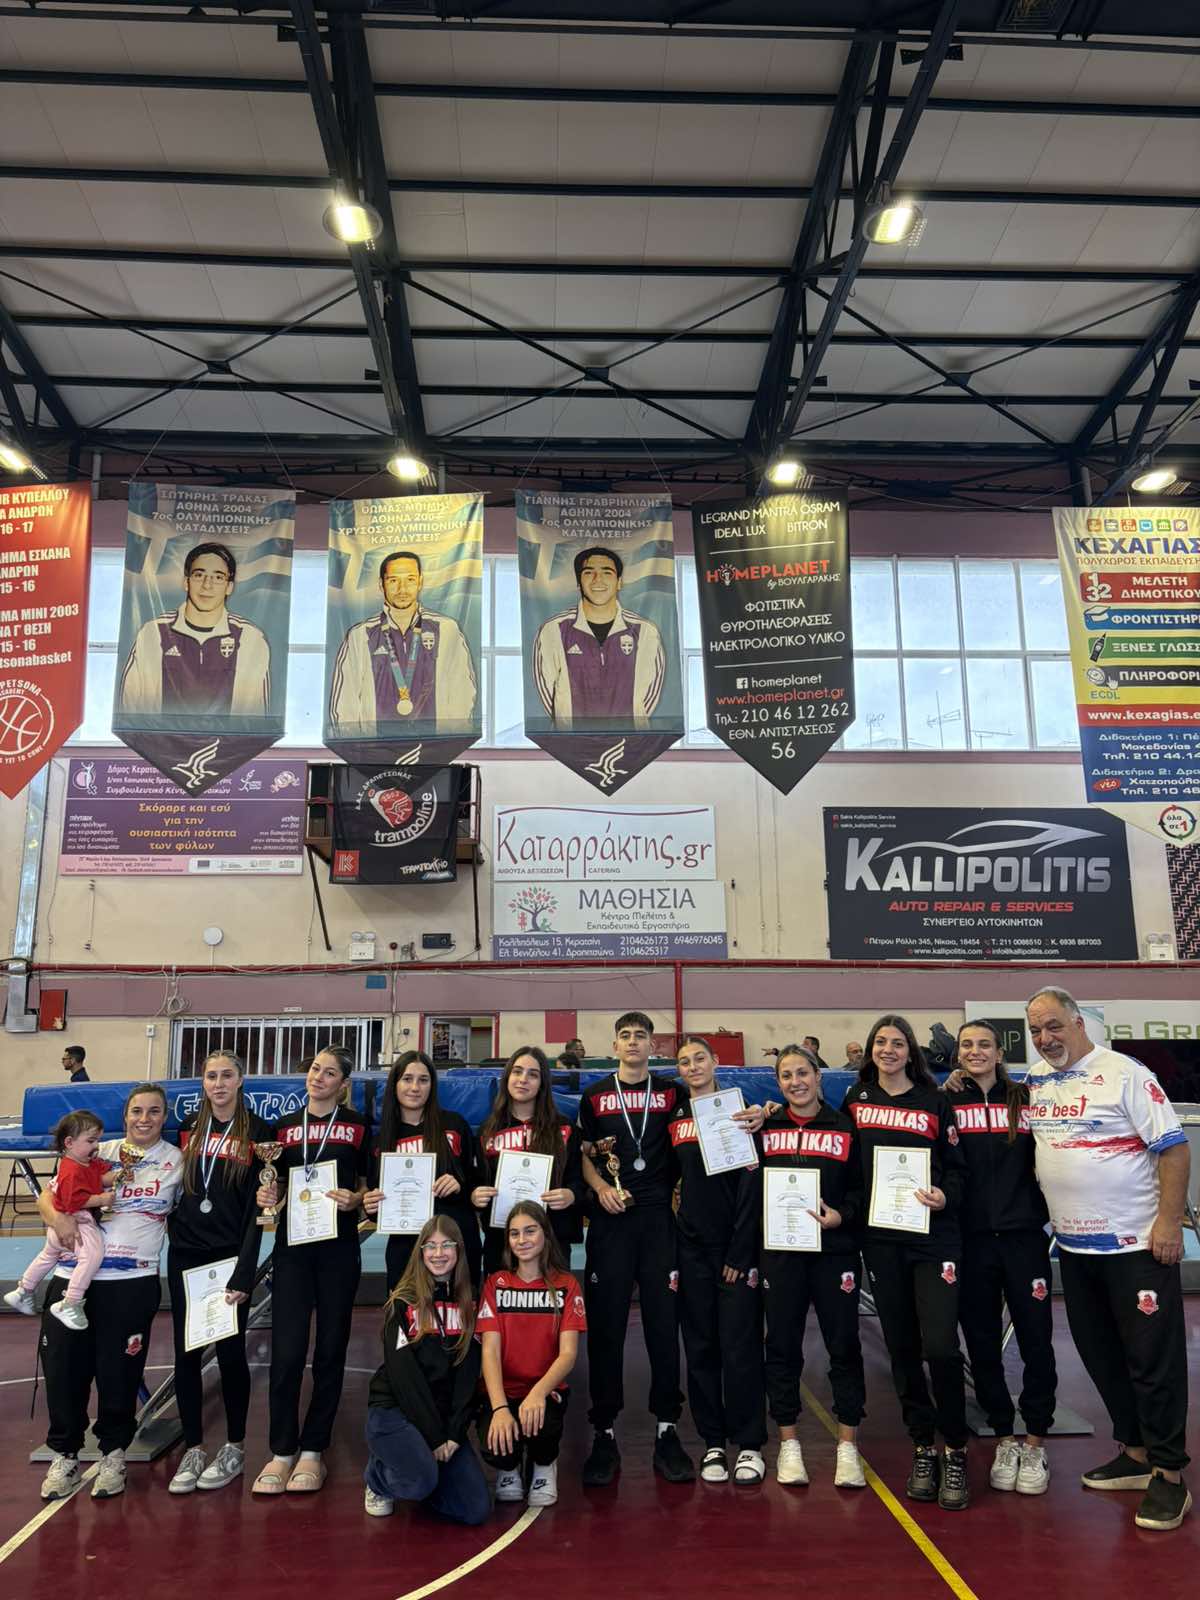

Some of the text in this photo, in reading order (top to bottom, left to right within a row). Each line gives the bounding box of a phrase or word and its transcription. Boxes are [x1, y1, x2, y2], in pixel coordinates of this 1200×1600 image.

[12, 489, 69, 504] ΚΥΠΕΛΛΟΥ
[160, 490, 268, 504] ΣΩΤΗΡΗΣ ΤΡΑΚΑΣ
[525, 496, 576, 506] ΓΙΑΝΝΗΣ
[9, 505, 53, 518] ΑΝΔΡΩΝ
[176, 502, 252, 513] ΑΘΗΝΑ 2004
[560, 508, 632, 518] ΑΘΗΝΑ 2004
[700, 502, 840, 524] LEGRAND MANTRA OSRAM
[152, 512, 272, 525] 7ος ΟΛΥΜΠΙΟΝΙΚΗΣ
[371, 514, 411, 524] ΑΘΗΝΑ
[564, 519, 653, 528] ΟΛΥΜΠΙΟΝΙΚΗΣ
[1, 522, 34, 534] 16 17
[176, 523, 250, 534] ΚΑΤΑΔΥΣΕΙΣ
[338, 521, 474, 536] ΧΡΥΣΟΣ ΟΛΥΜΠΙΟΝΙΚΗΣ
[562, 530, 632, 538] ΚΑΤΑΔΥΣΕΙΣ
[714, 520, 828, 539] IDEAL LUX BITRON
[371, 533, 440, 544] ΚΑΤΑΔΥΣΕΙΣ
[1074, 538, 1200, 554] ΚΕΧΑΓΙΑΣ
[0, 547, 71, 564] ΗΜΑ ΕΣΚΑΝΑ
[778, 573, 840, 586] ΒΟΥΛΓΑΡΑΚΗΣ
[1132, 576, 1188, 586] ΜΕΛΕΤΗ
[1, 580, 36, 594] 15 16
[1120, 589, 1200, 598] ΔΗΜΟΤΙΚΟΥ
[21, 608, 48, 620] ΜΙΝΙ
[50, 604, 79, 619] 2003
[744, 598, 805, 613] ΦΩΤΙΣΤΙΚΑ
[24, 622, 52, 636] ΘΕΣΗ
[720, 614, 832, 632] ΘΥΡΟΤΗΛΕΟΡΑΣΕΙΣ
[1, 639, 36, 652] 15 16
[710, 632, 845, 652] ΗΛΕΚΤΡΟΛΟΓΙΚΟ ΥΛΙΚΟ
[1112, 643, 1156, 652] ΞΕΝΕΣ
[752, 674, 822, 690] homeplanet
[716, 688, 844, 706] www.homeplanet.gr
[1090, 690, 1120, 700] ECDL
[741, 709, 770, 722] 210
[774, 706, 792, 720] 46
[797, 704, 816, 719] 12
[821, 702, 849, 718] 262
[729, 723, 836, 740] ΕΘΝ. ΑΝΤΙΣΤΑΣΕΩΣ
[1099, 733, 1162, 742] Διδακτήριο
[771, 742, 796, 759] 56
[1103, 752, 1130, 760] Τηλ.
[1092, 768, 1154, 776] Διδακτήριο
[139, 803, 231, 813] Σκόραρε και εσύ
[164, 817, 204, 826] για την
[374, 792, 433, 843] trampoline
[129, 828, 236, 838] ουσιαστική ισότητα
[150, 841, 214, 851] των φύλων
[497, 816, 713, 878] Καταρράκτης.gr
[845, 837, 1110, 892] KALLIPOLITIS
[579, 887, 696, 910] ΜΑΘΗΣΙΑ
[888, 902, 1074, 912] AUTO REPAIR & SERVICES
[600, 912, 675, 921] Κέντρα Μελέτης &
[923, 917, 1043, 928] ΣΥΝΕΡΓΕΙΟ ΑΥΤΟΚΙΝΗΤΩΝ
[587, 922, 690, 931] Εκπαιδευτικά Εργαστήρια
[499, 938, 550, 948] Καλλιπόλεως
[620, 936, 669, 944] 2104626173
[674, 936, 723, 944] 6946976045
[869, 937, 894, 946] Πέτρου
[620, 947, 669, 955] 2104625317
[1052, 1094, 1089, 1117] best
[856, 1106, 928, 1132] FOINIKAS
[763, 1132, 843, 1155] FOINIKAS
[122, 1178, 161, 1198] best
[496, 1289, 564, 1308] FOINIKAS
